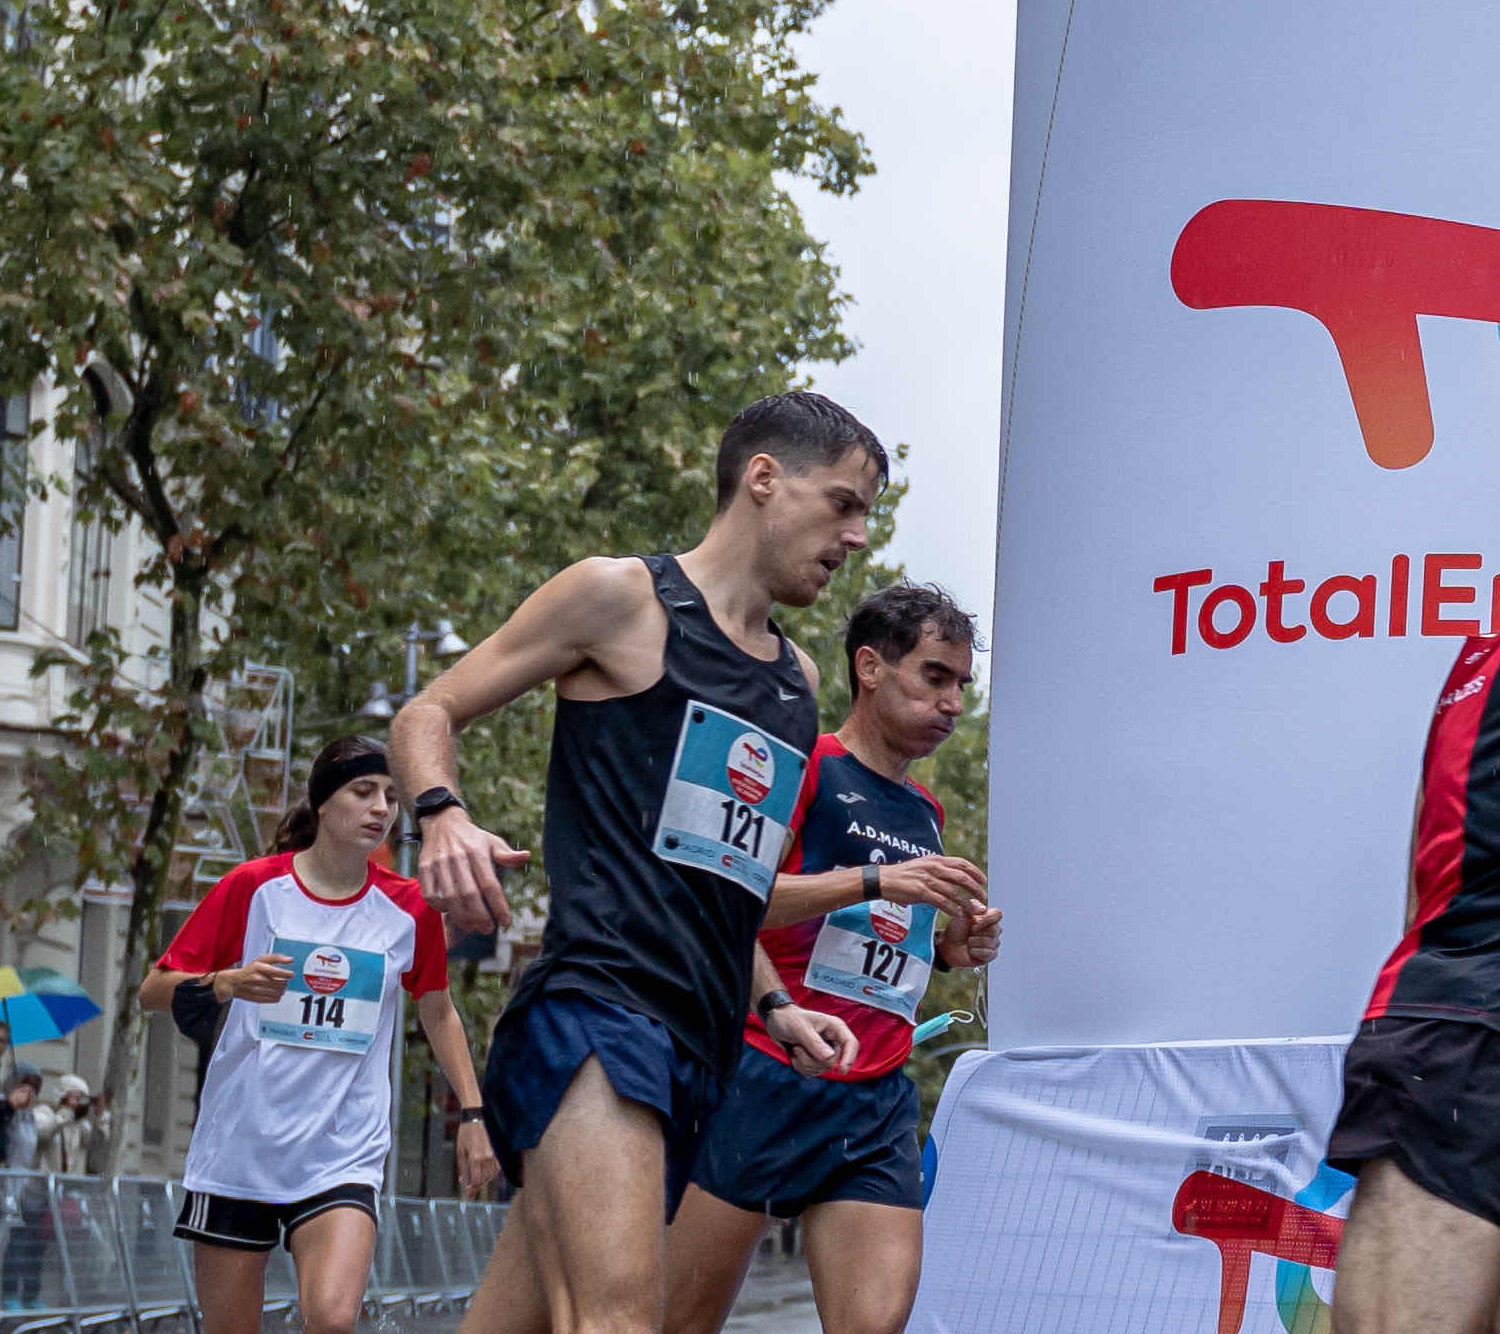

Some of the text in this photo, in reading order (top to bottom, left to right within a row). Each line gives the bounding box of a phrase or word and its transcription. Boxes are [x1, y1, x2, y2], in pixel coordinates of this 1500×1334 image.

[721, 799, 766, 859] 121
[861, 938, 909, 988] 127
[299, 993, 345, 1029] 114
